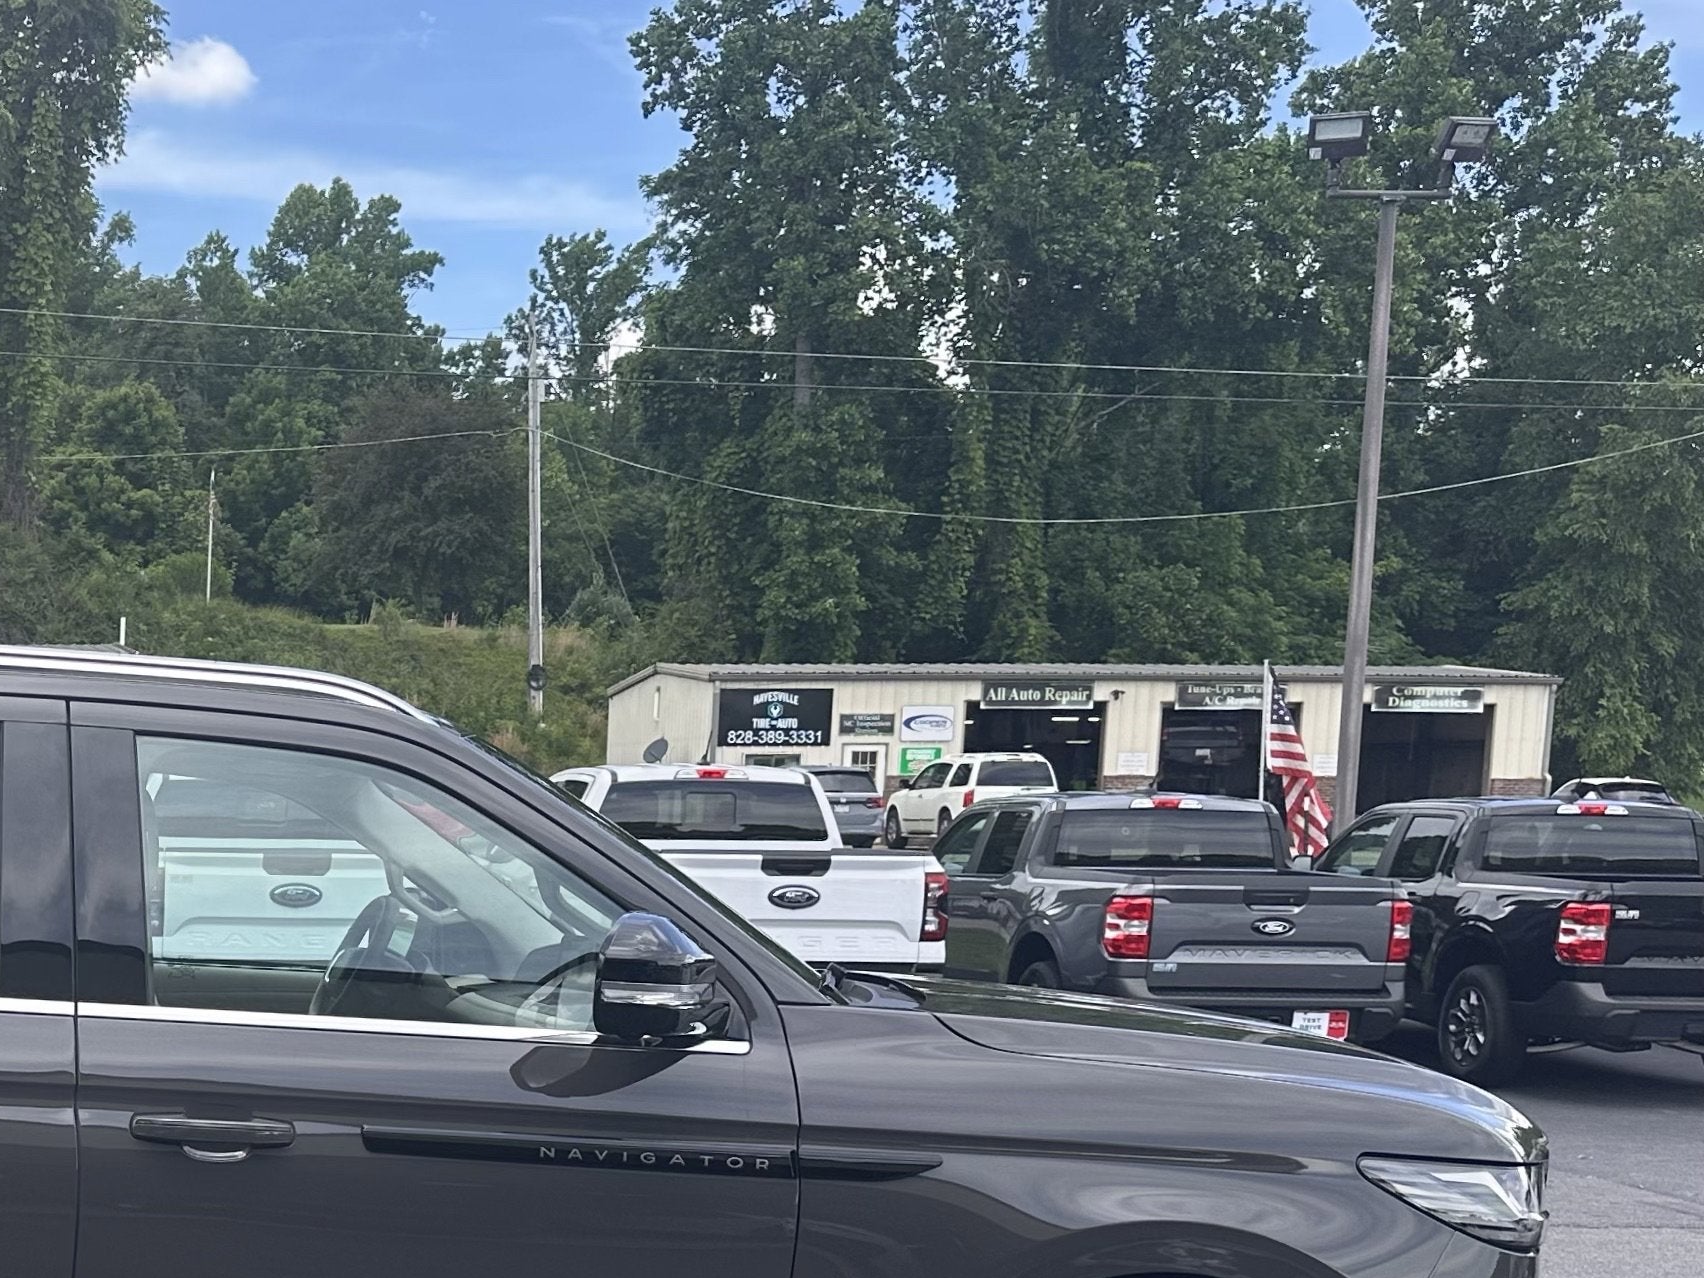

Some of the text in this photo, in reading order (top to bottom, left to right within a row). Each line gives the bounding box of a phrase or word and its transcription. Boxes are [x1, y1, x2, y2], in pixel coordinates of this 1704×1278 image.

[752, 691, 800, 706] HAYESVILLE
[986, 687, 1090, 705] All Auto Repair
[1392, 686, 1463, 698] Computer
[1388, 696, 1469, 709] Diagnostics
[727, 730, 822, 744] 828-389-3331
[539, 1146, 769, 1170] NAVIGATOR
